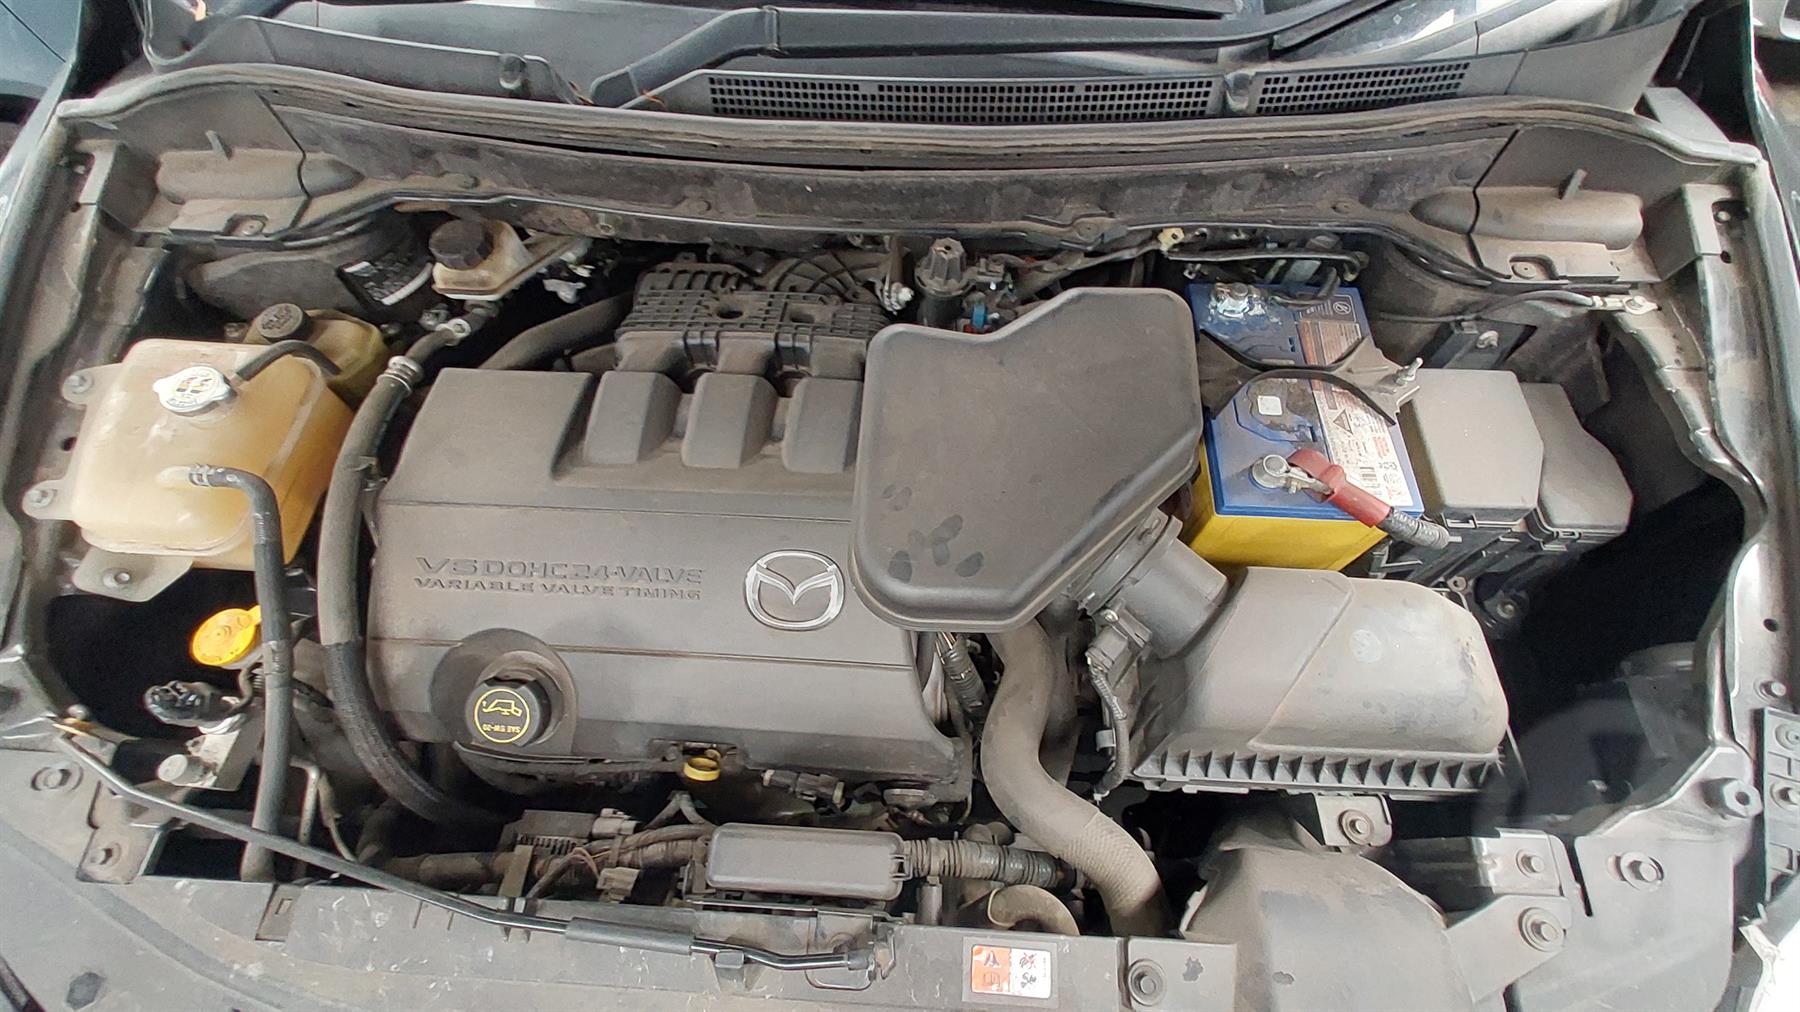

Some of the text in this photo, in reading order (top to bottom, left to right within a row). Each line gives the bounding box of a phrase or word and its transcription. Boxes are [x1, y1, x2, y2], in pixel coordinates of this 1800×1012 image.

[483, 559, 568, 579] DOHC
[413, 577, 702, 600] VARIABLE VALVE TIMING
